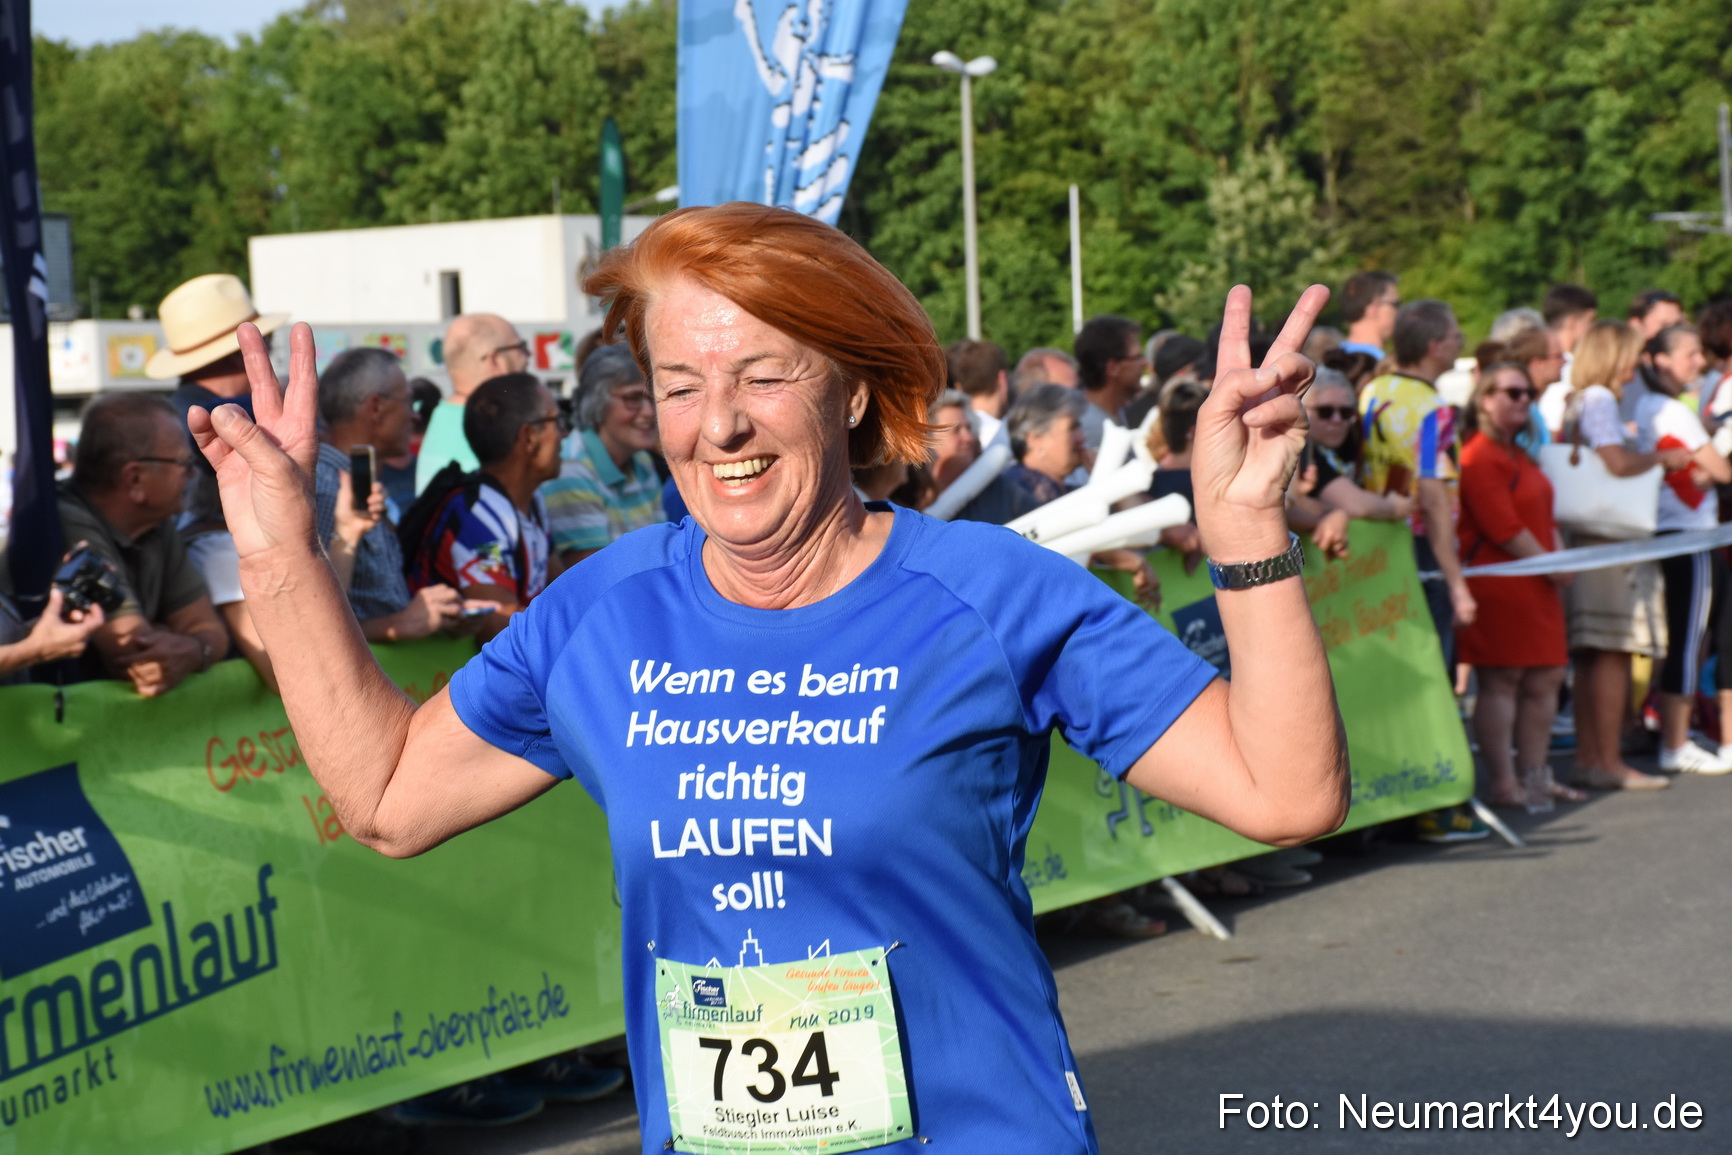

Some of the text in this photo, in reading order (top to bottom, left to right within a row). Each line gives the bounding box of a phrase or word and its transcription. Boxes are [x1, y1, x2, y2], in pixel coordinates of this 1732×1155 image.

[629, 659, 899, 697] Wenn es beim
[626, 705, 886, 747] Hausverkauf
[678, 761, 806, 806] richtig
[650, 818, 833, 859] LAUFEN
[14, 852, 96, 892] AUTOMOBILE
[712, 870, 786, 912] soll!
[683, 1001, 763, 1022] firmenlauf
[789, 1005, 874, 1029] run 2019
[205, 972, 570, 1119] www.firmenlauf-oberpfalz.de
[698, 1031, 840, 1103] 734
[703, 1124, 757, 1140] Feldbusch
[761, 1125, 832, 1140] Immobilien
[836, 1120, 862, 1134] e.K.
[715, 1105, 839, 1128] Stiegler Luise
